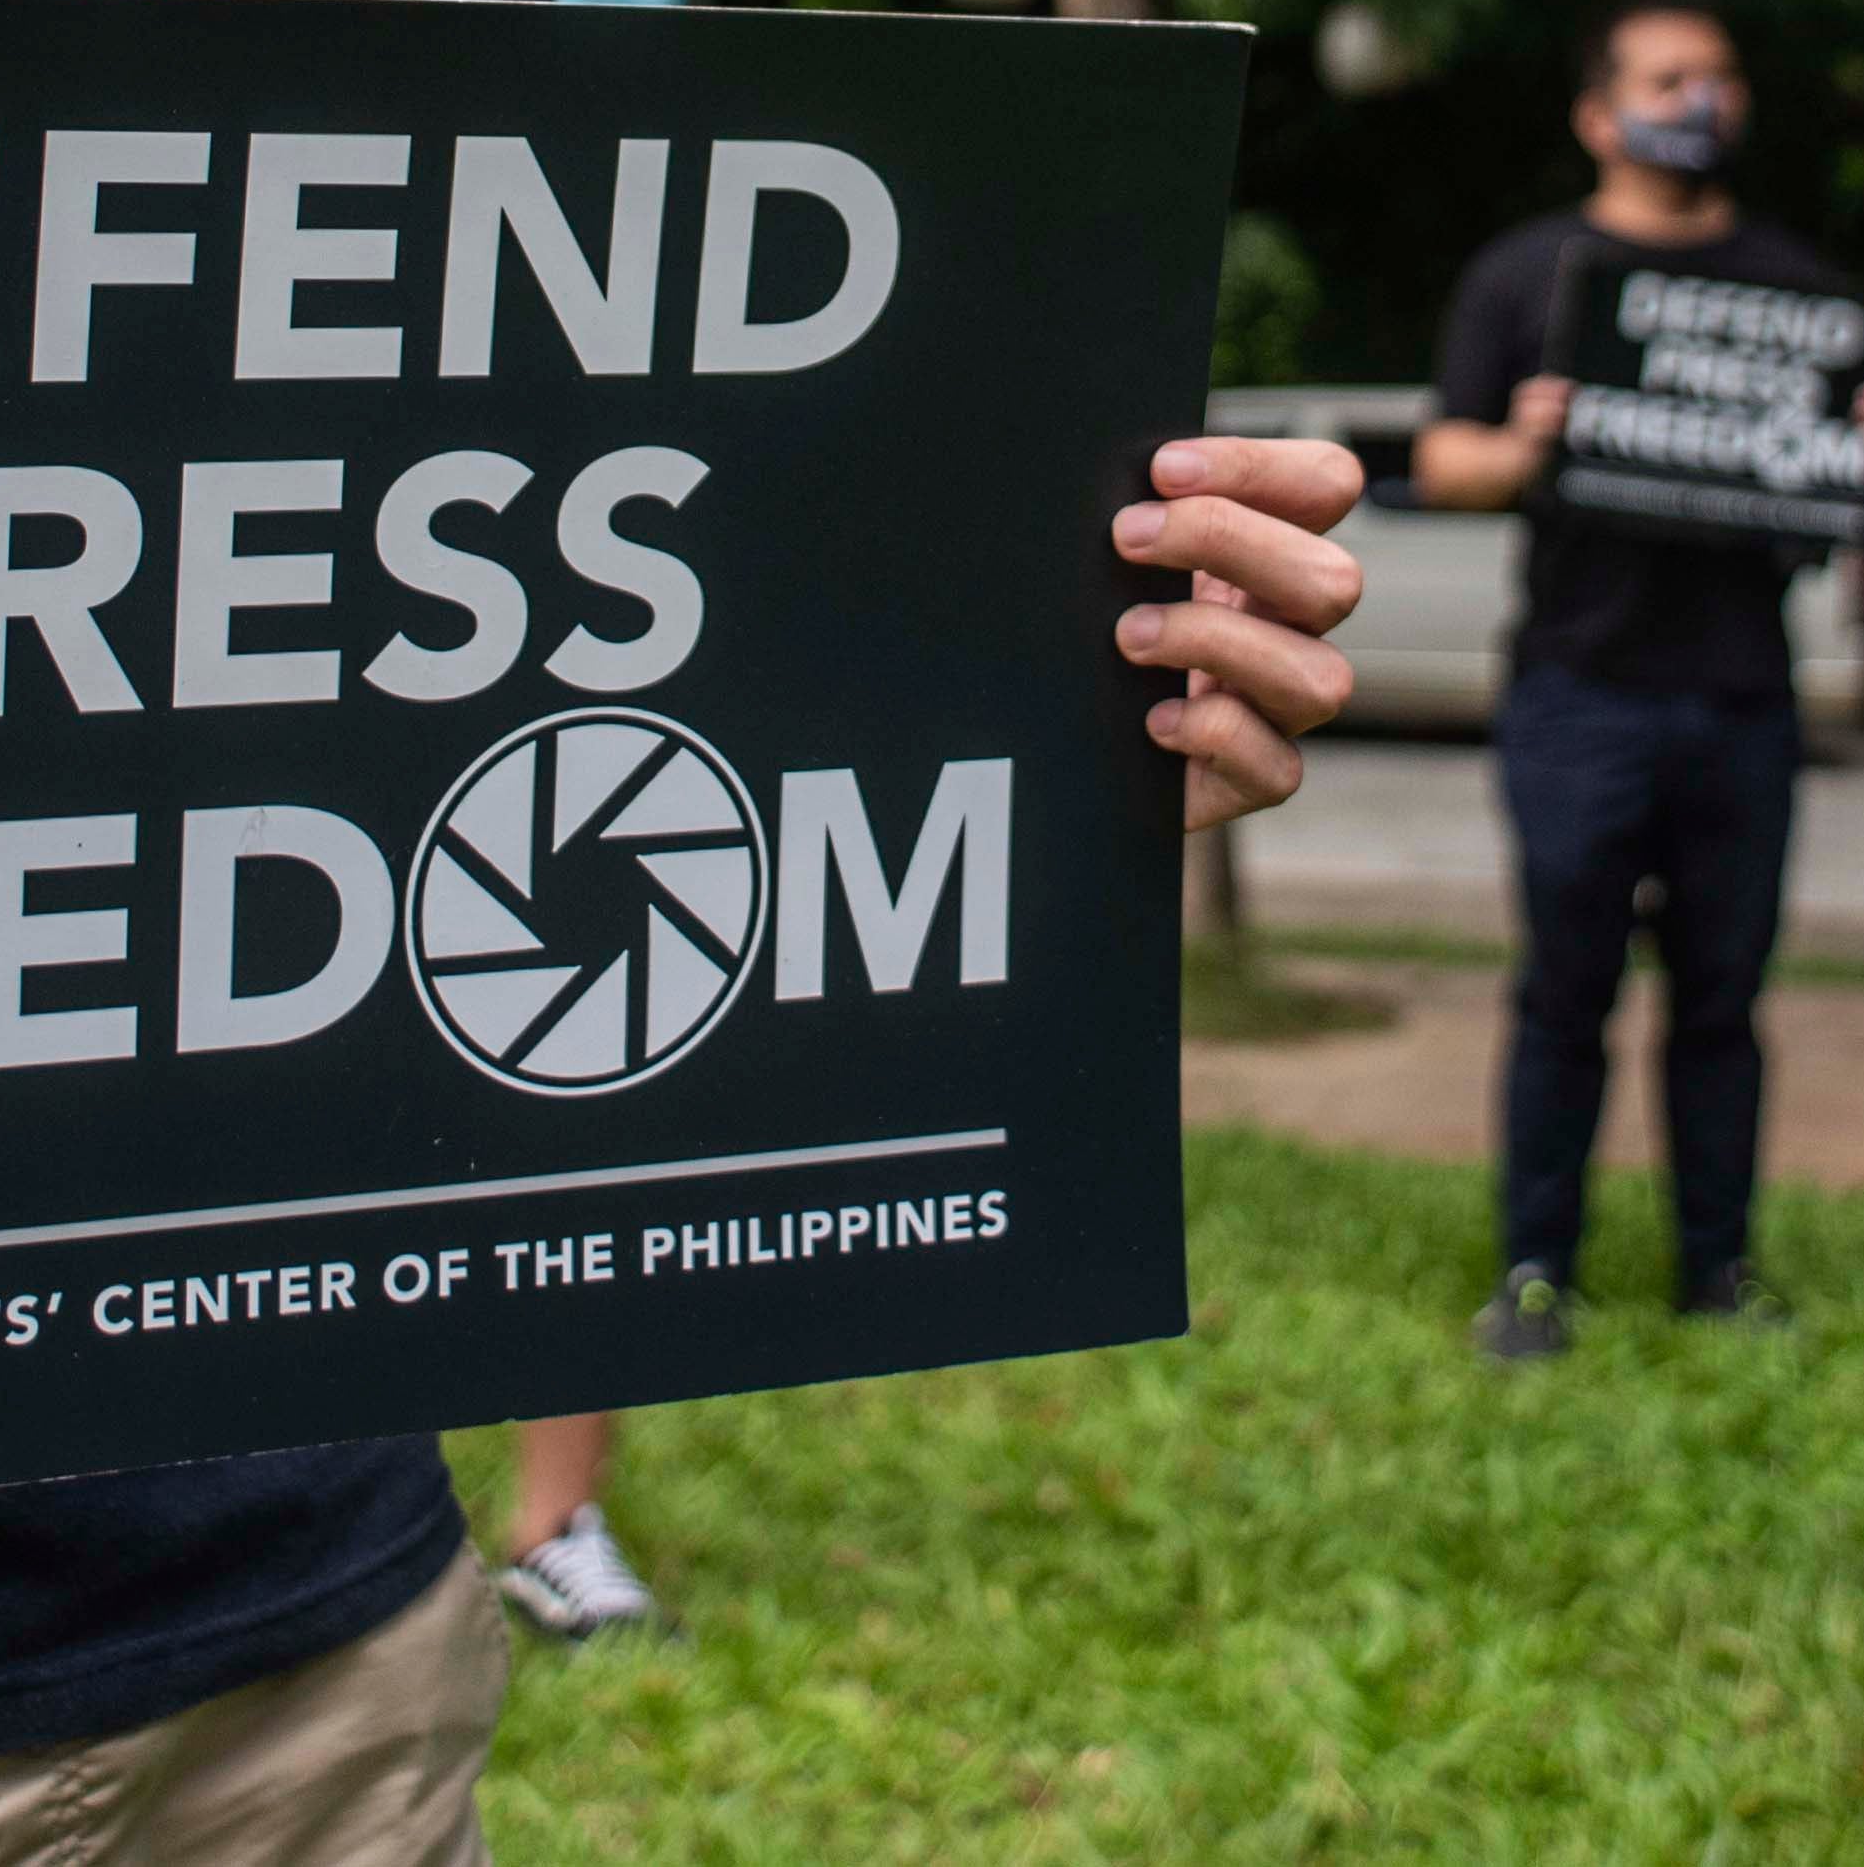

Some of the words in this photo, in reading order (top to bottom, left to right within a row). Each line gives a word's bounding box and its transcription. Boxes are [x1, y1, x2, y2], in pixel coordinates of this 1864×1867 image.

[1640, 337, 1832, 417] PRESS
[92, 1262, 356, 1335] CENTER
[383, 1248, 470, 1304] OF
[494, 1233, 616, 1290] THE
[642, 1190, 1009, 1276] PHILIPPINES
